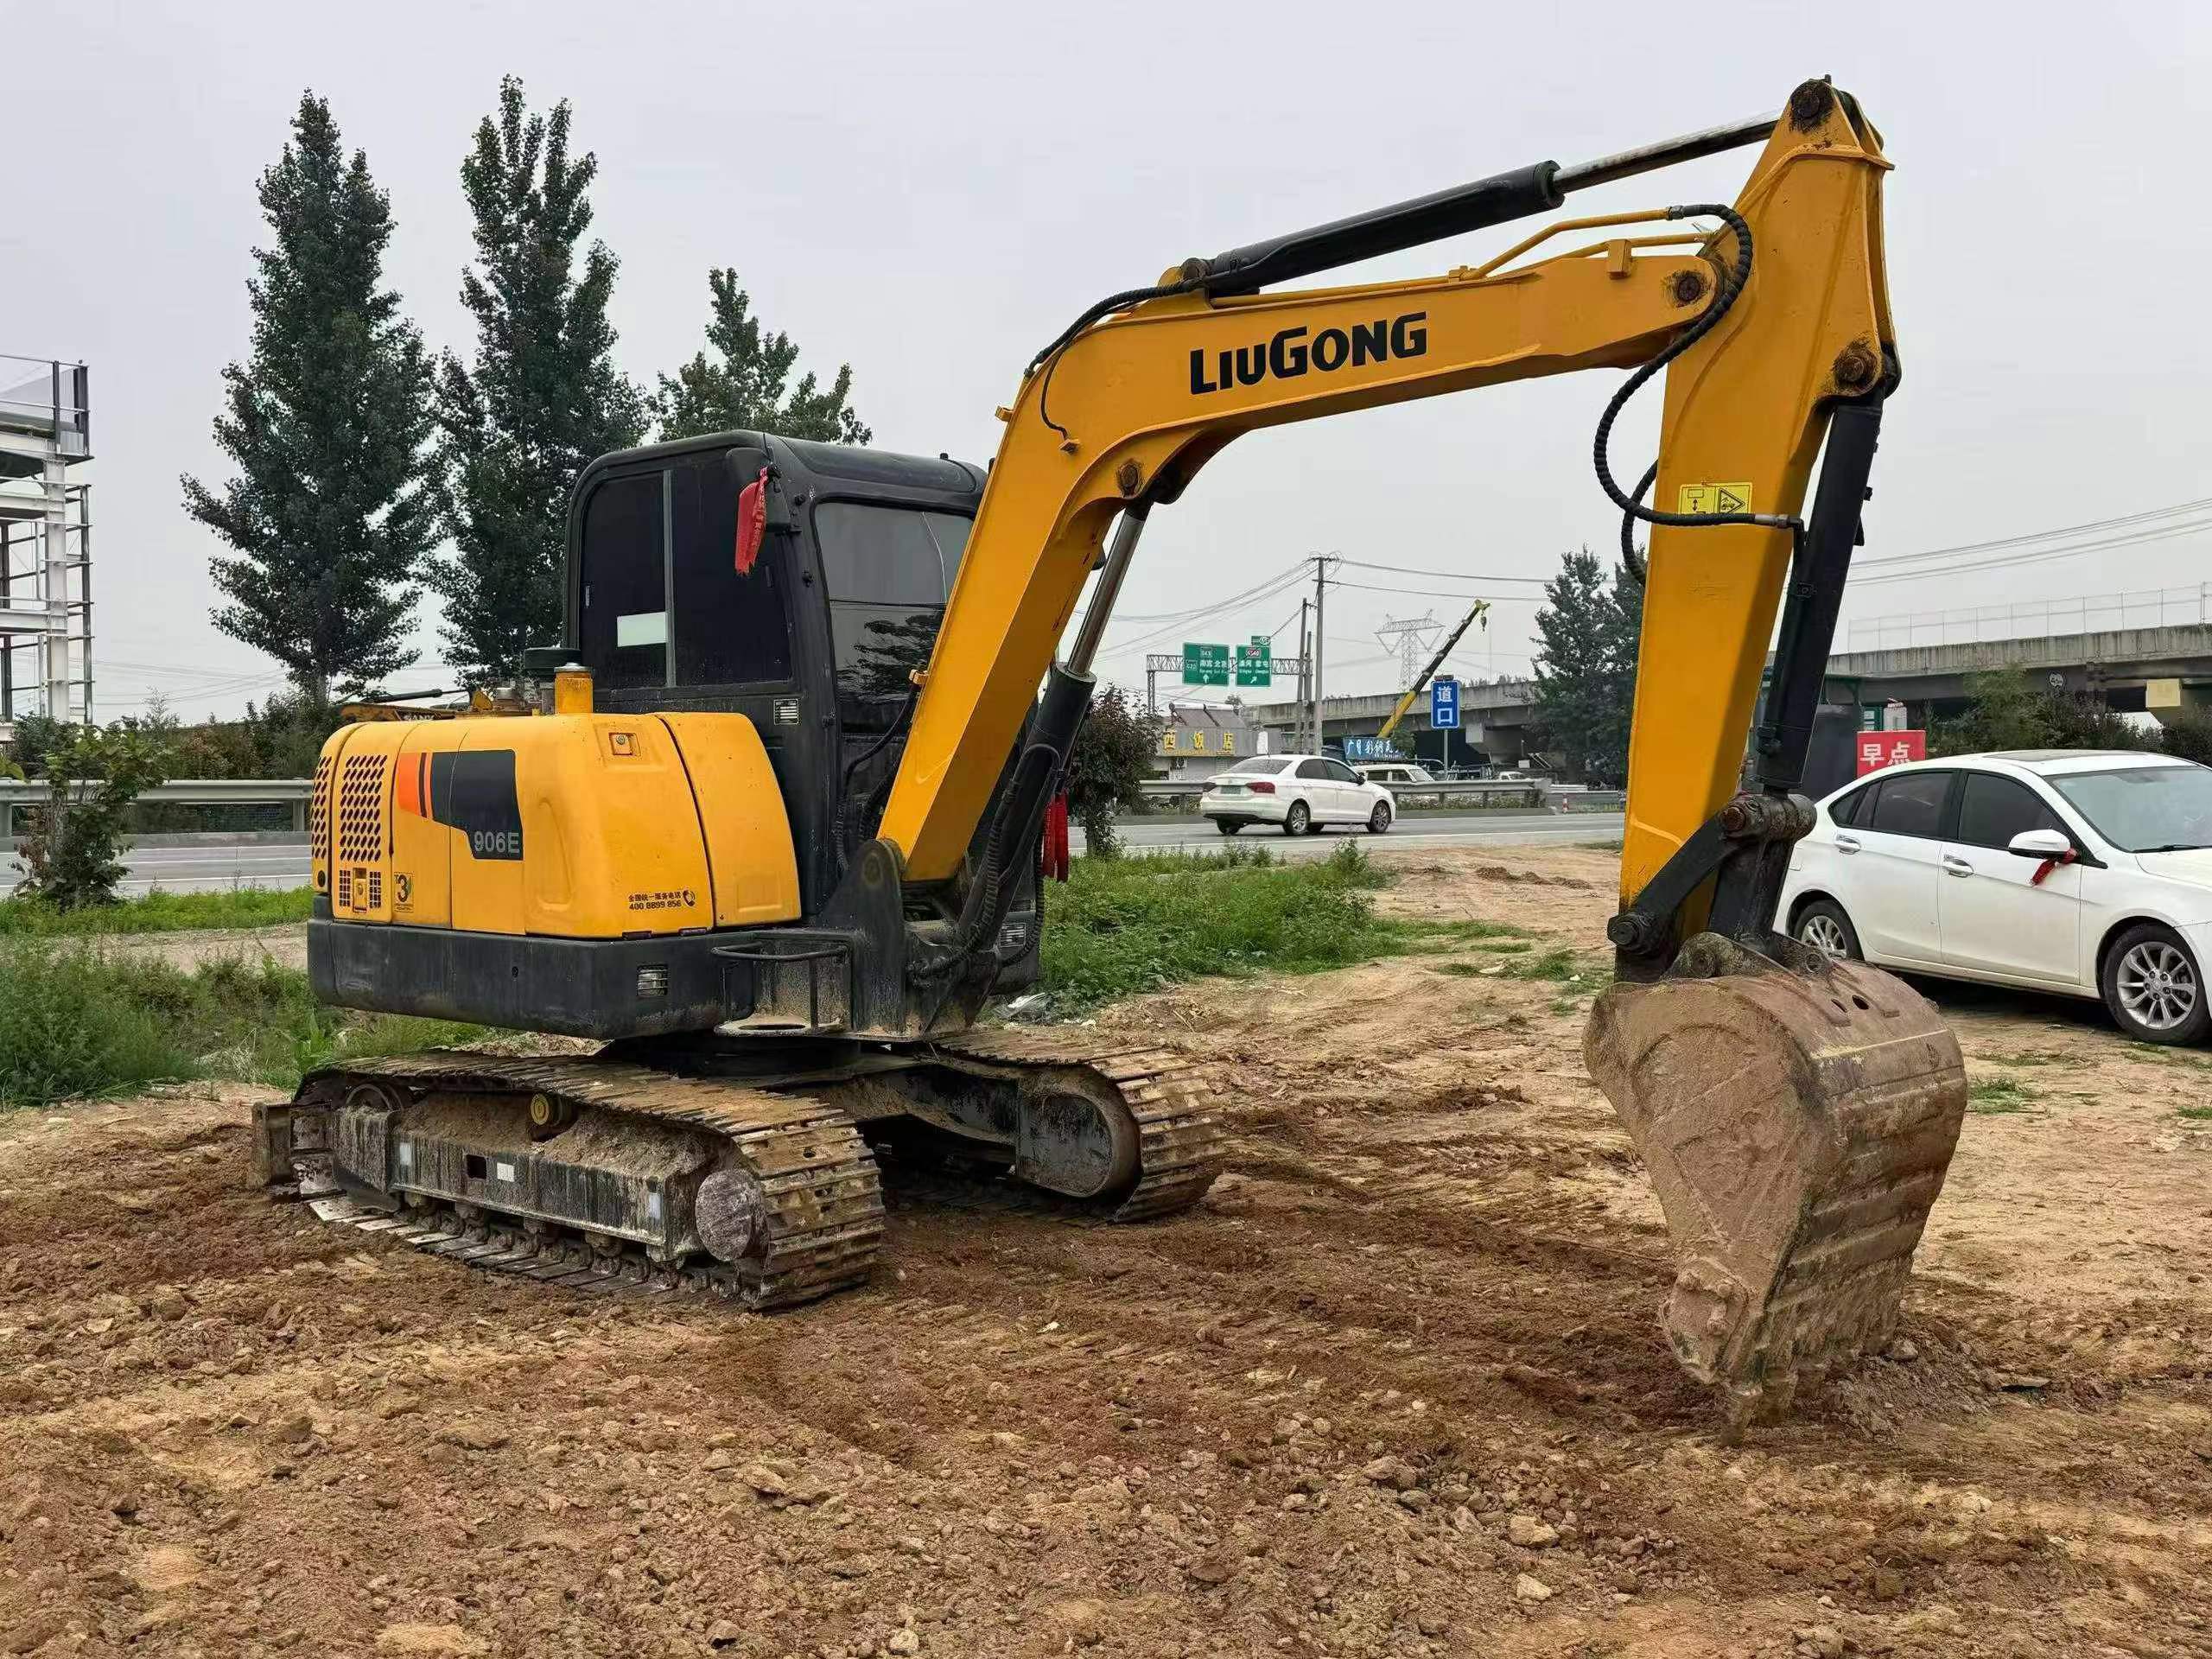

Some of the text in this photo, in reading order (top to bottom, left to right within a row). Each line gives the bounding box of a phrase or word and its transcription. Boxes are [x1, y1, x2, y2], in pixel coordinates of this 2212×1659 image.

[1190, 311, 1427, 395] LIUGONG
[1437, 685, 1453, 725] 道口
[1859, 741, 1910, 767] 早点
[474, 830, 520, 854] 906E
